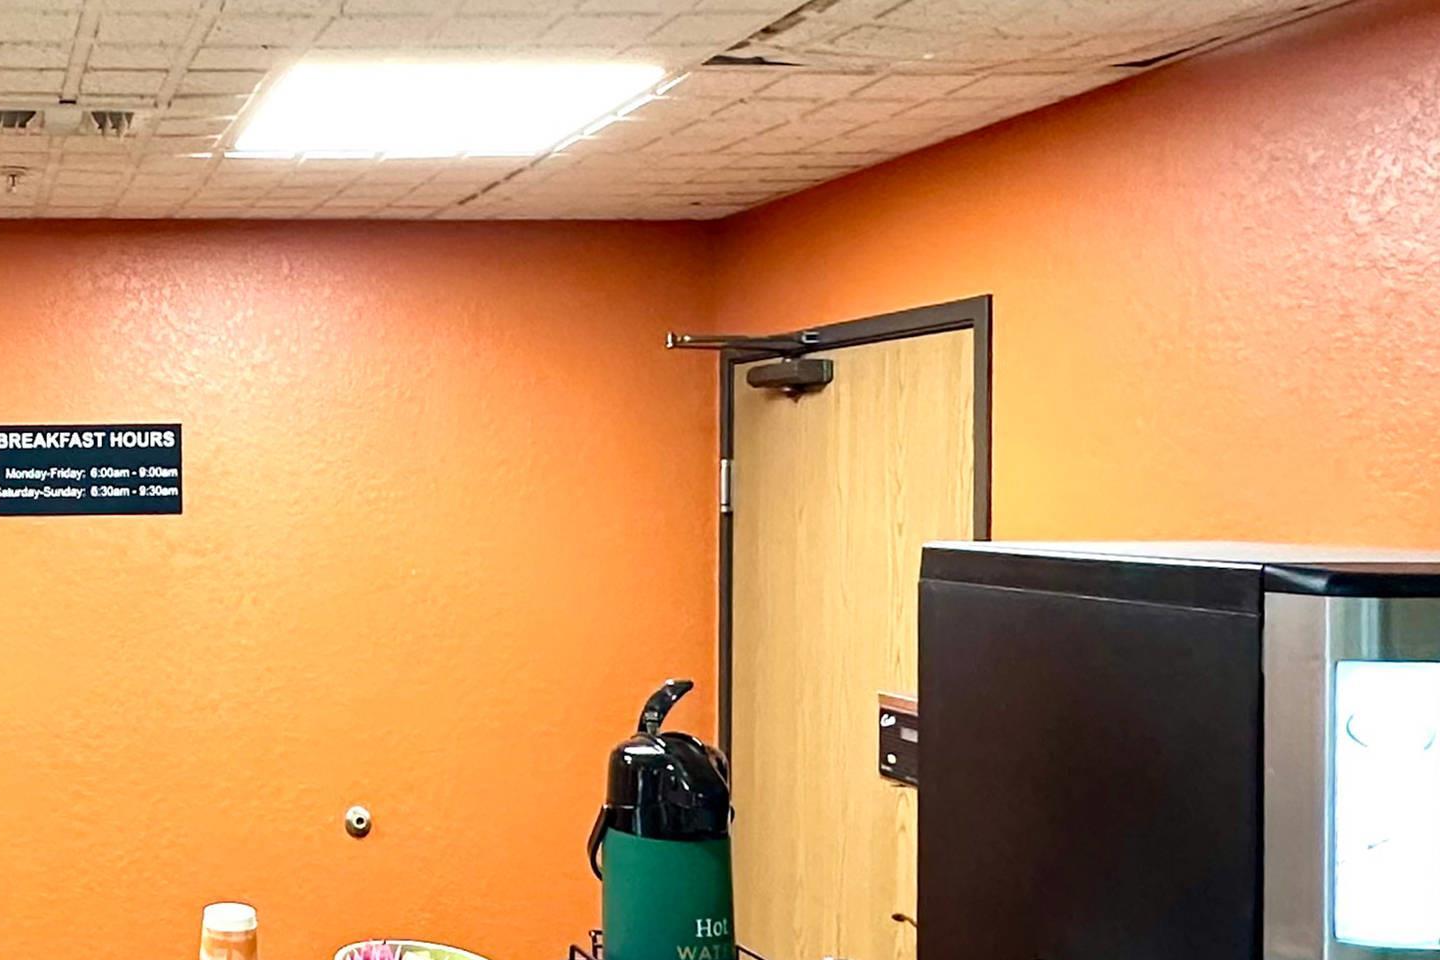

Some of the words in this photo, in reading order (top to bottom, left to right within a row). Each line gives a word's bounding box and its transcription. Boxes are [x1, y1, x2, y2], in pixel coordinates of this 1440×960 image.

[110, 430, 176, 448] HOURS
[5, 467, 86, 481] Monday-Friday:
[90, 467, 130, 478] 6:00am
[138, 466, 178, 478] 9:00am
[695, 918, 728, 937] Hot
